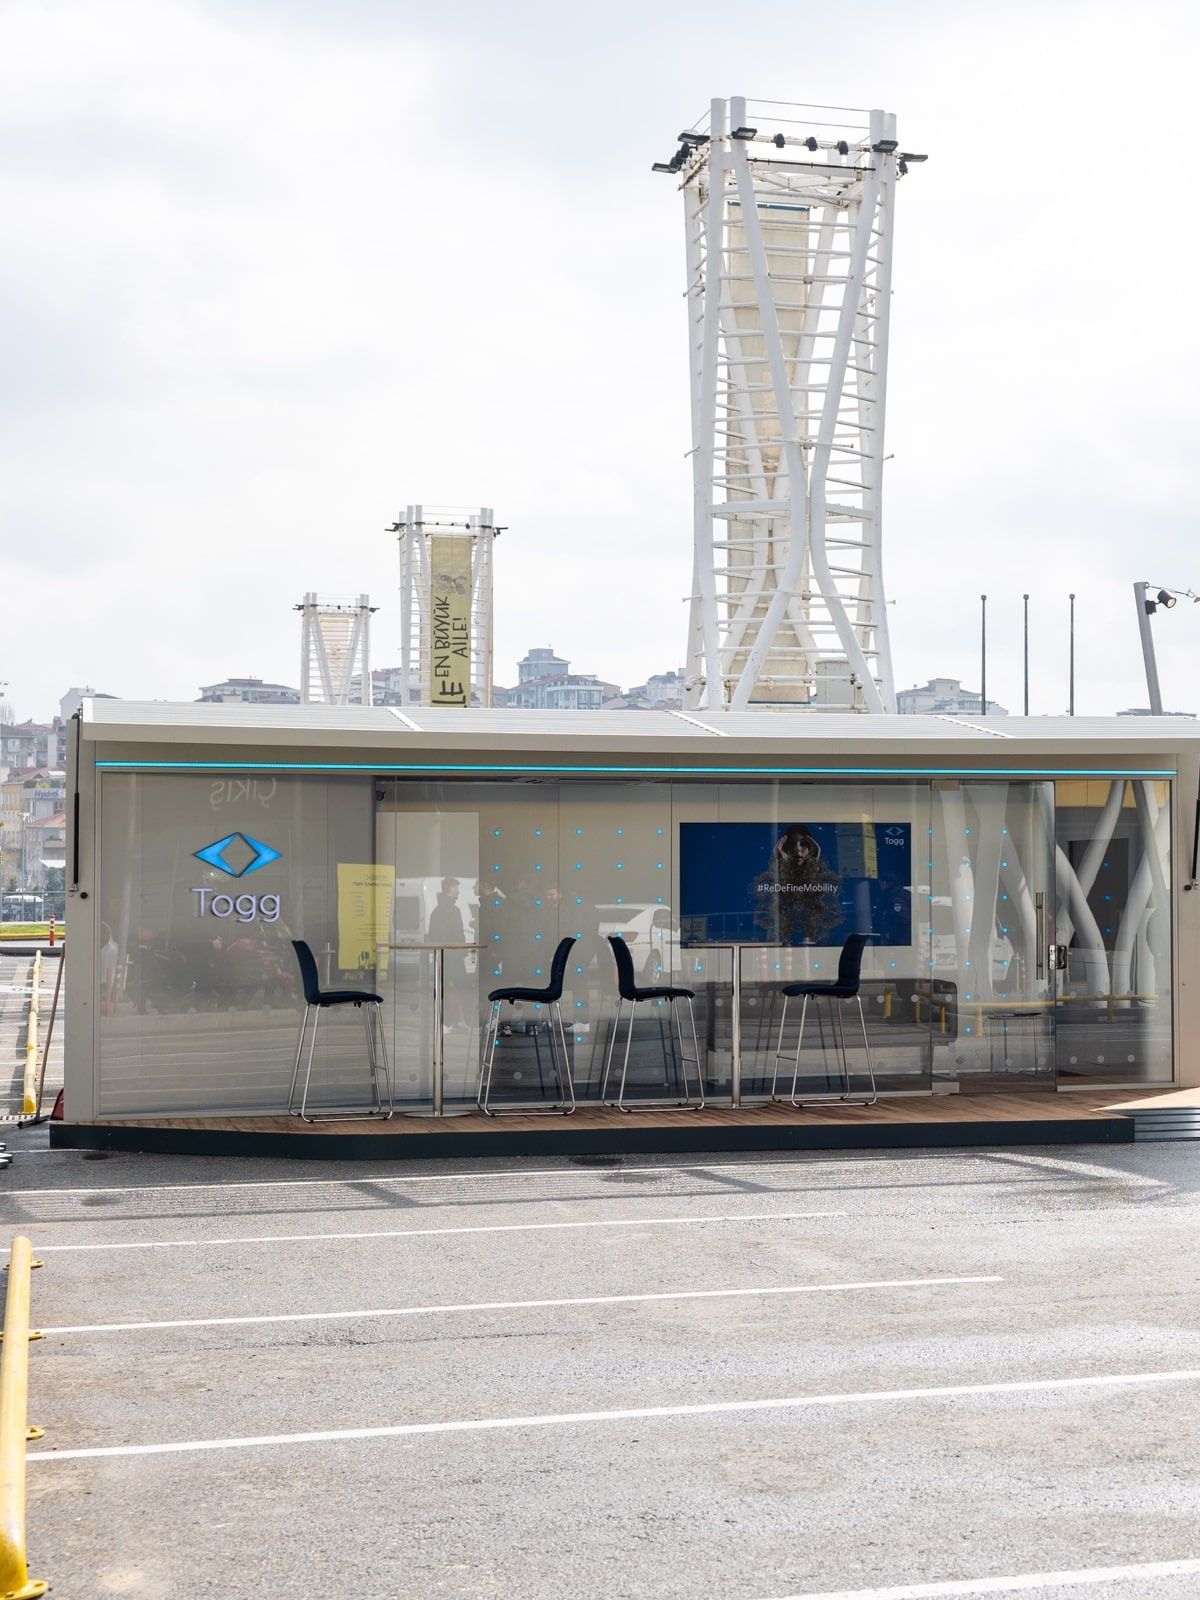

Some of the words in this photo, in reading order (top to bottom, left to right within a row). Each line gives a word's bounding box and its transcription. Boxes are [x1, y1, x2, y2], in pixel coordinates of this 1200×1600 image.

[433, 596, 451, 650] BÜYÜK
[434, 655, 452, 677] EN
[884, 837, 905, 846] Togg
[757, 882, 839, 894] #ReDeFineMobility
[191, 887, 281, 923] Togg
